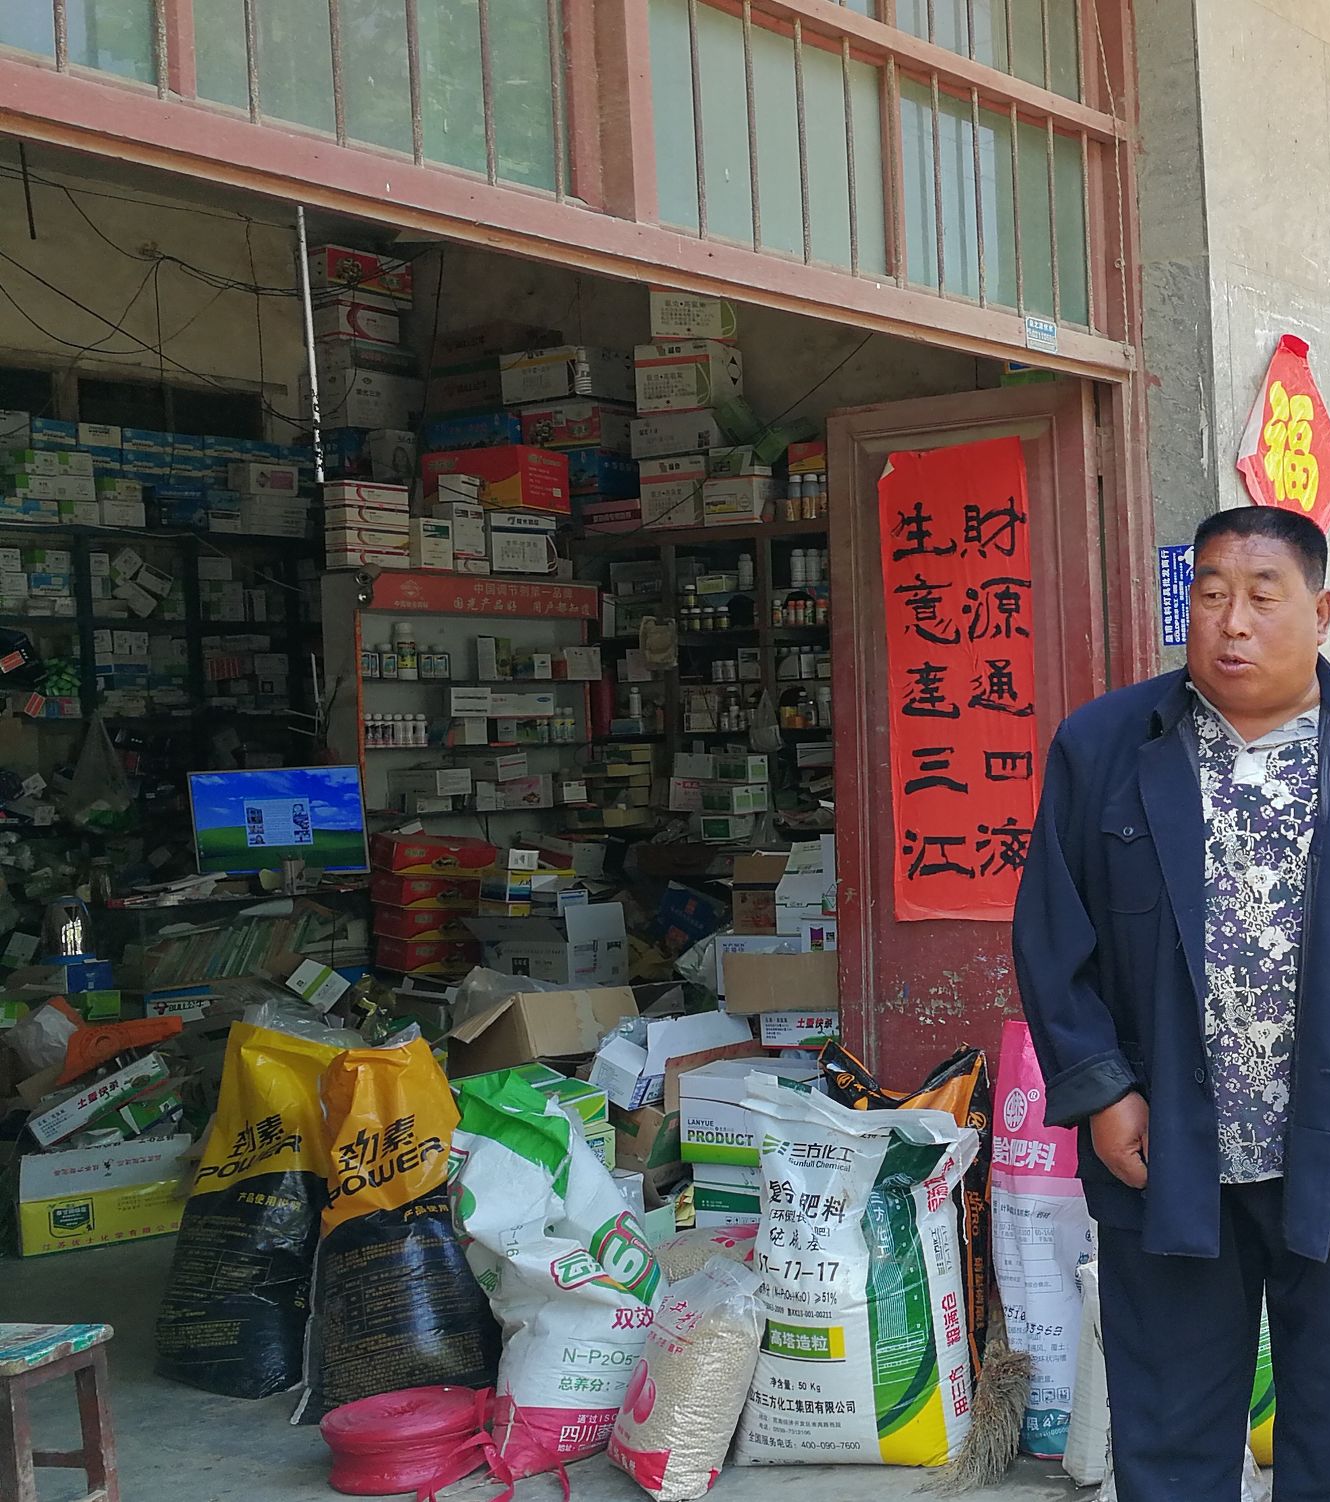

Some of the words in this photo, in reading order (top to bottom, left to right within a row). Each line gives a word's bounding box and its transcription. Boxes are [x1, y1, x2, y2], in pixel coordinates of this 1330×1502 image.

[1263, 380, 1320, 513] 福
[687, 1118, 715, 1128] LANYUE
[687, 1129, 755, 1147] PRODUCT
[790, 1142, 856, 1164] 三方化工
[612, 1307, 655, 1330] 双效
[769, 1328, 830, 1352] 高塔造粒
[798, 1381, 808, 1391] 50
[810, 1382, 822, 1393] Kg
[800, 1440, 861, 1451] 400-090-7600
